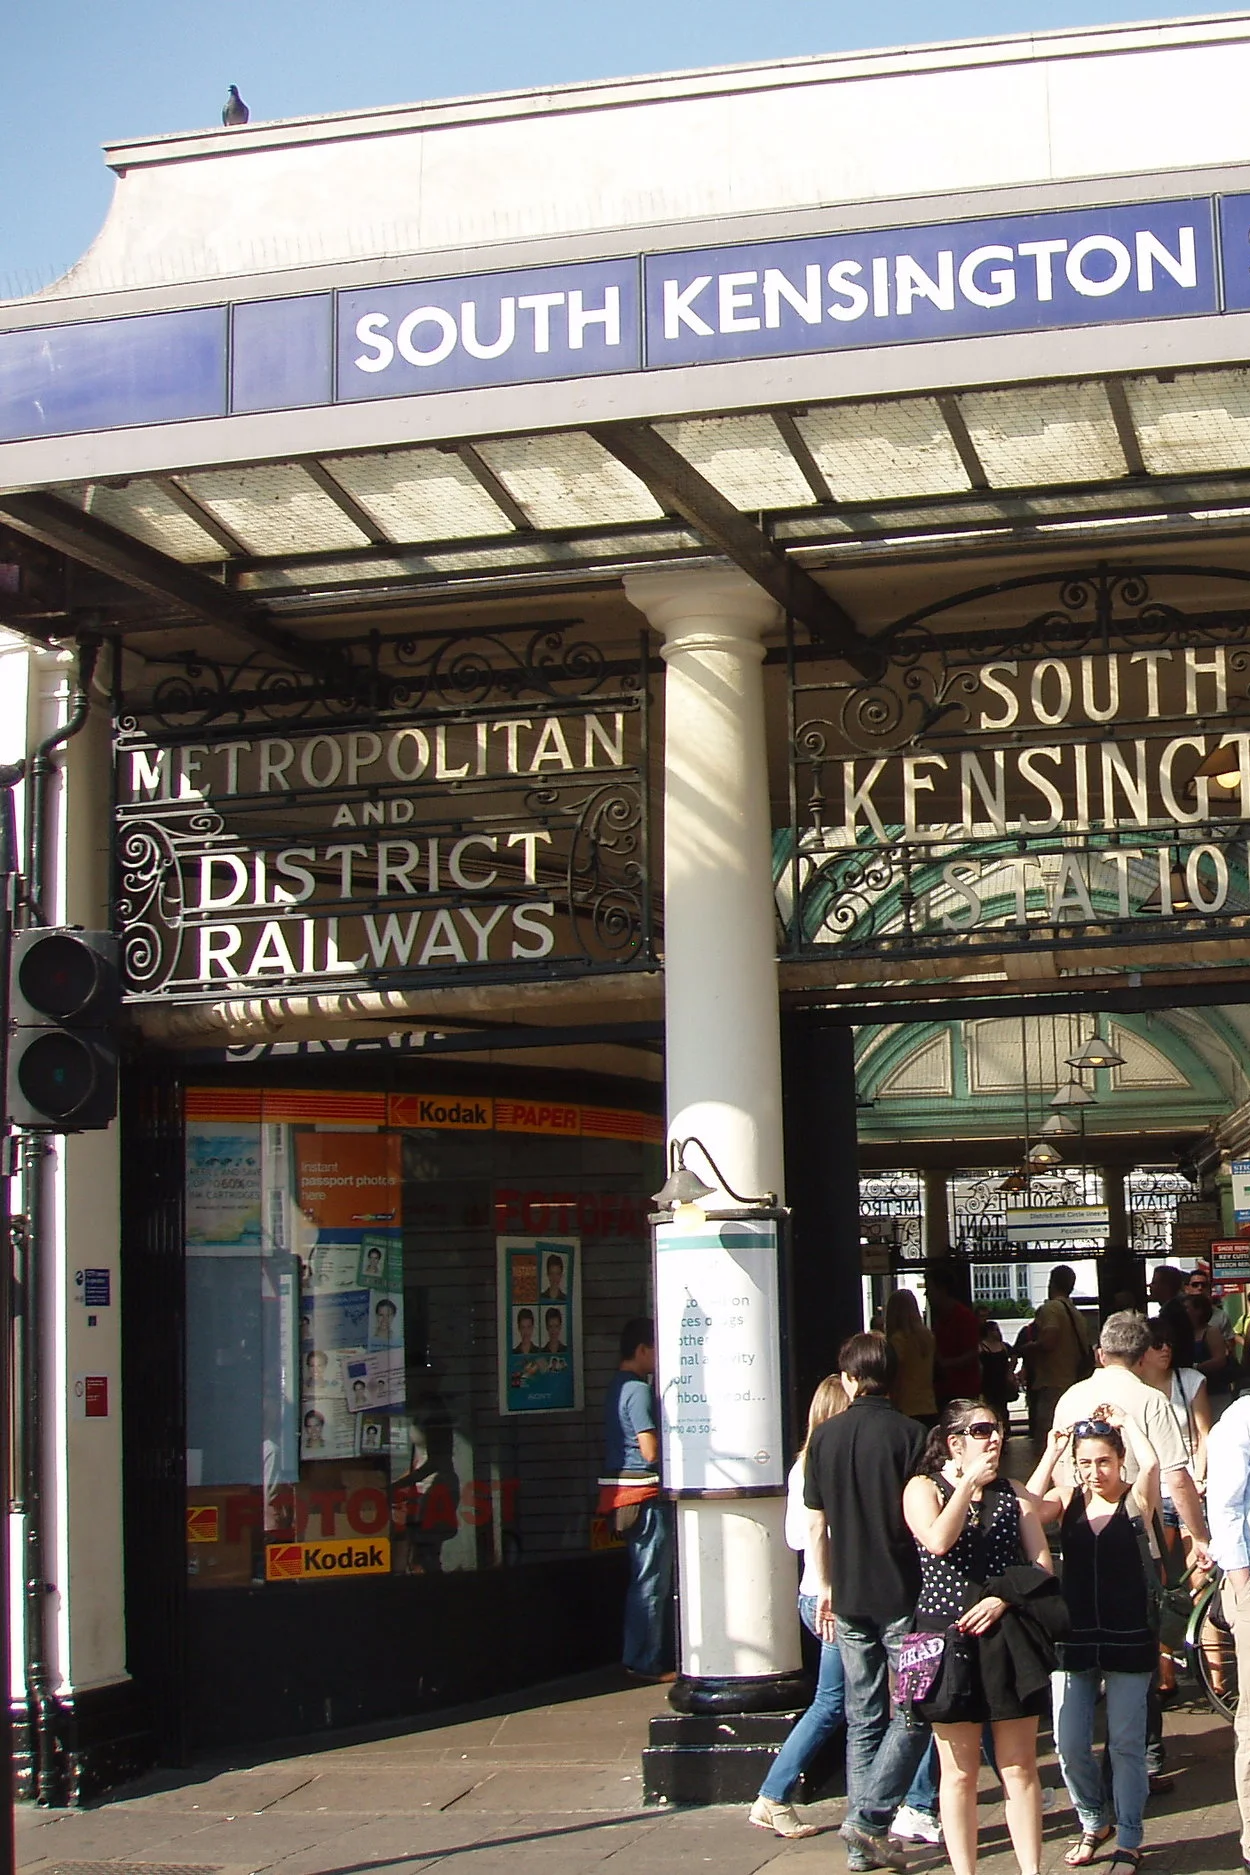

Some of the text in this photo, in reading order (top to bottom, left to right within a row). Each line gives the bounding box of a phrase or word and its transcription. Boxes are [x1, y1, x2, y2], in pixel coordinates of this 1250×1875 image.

[354, 285, 621, 374] SOUTH
[663, 225, 1197, 341] KENSINGTON
[979, 645, 1229, 730] SOUTH
[130, 712, 626, 803] METROPOLITAN
[331, 798, 416, 828] AND
[199, 831, 552, 910] DISTRICT
[199, 901, 556, 982] RAILWAYS
[419, 1100, 578, 1130] Kodak PAPER
[301, 1175, 396, 1189] passport photos
[224, 1478, 521, 1544] FOTOFAST
[304, 1545, 385, 1572] Kodak
